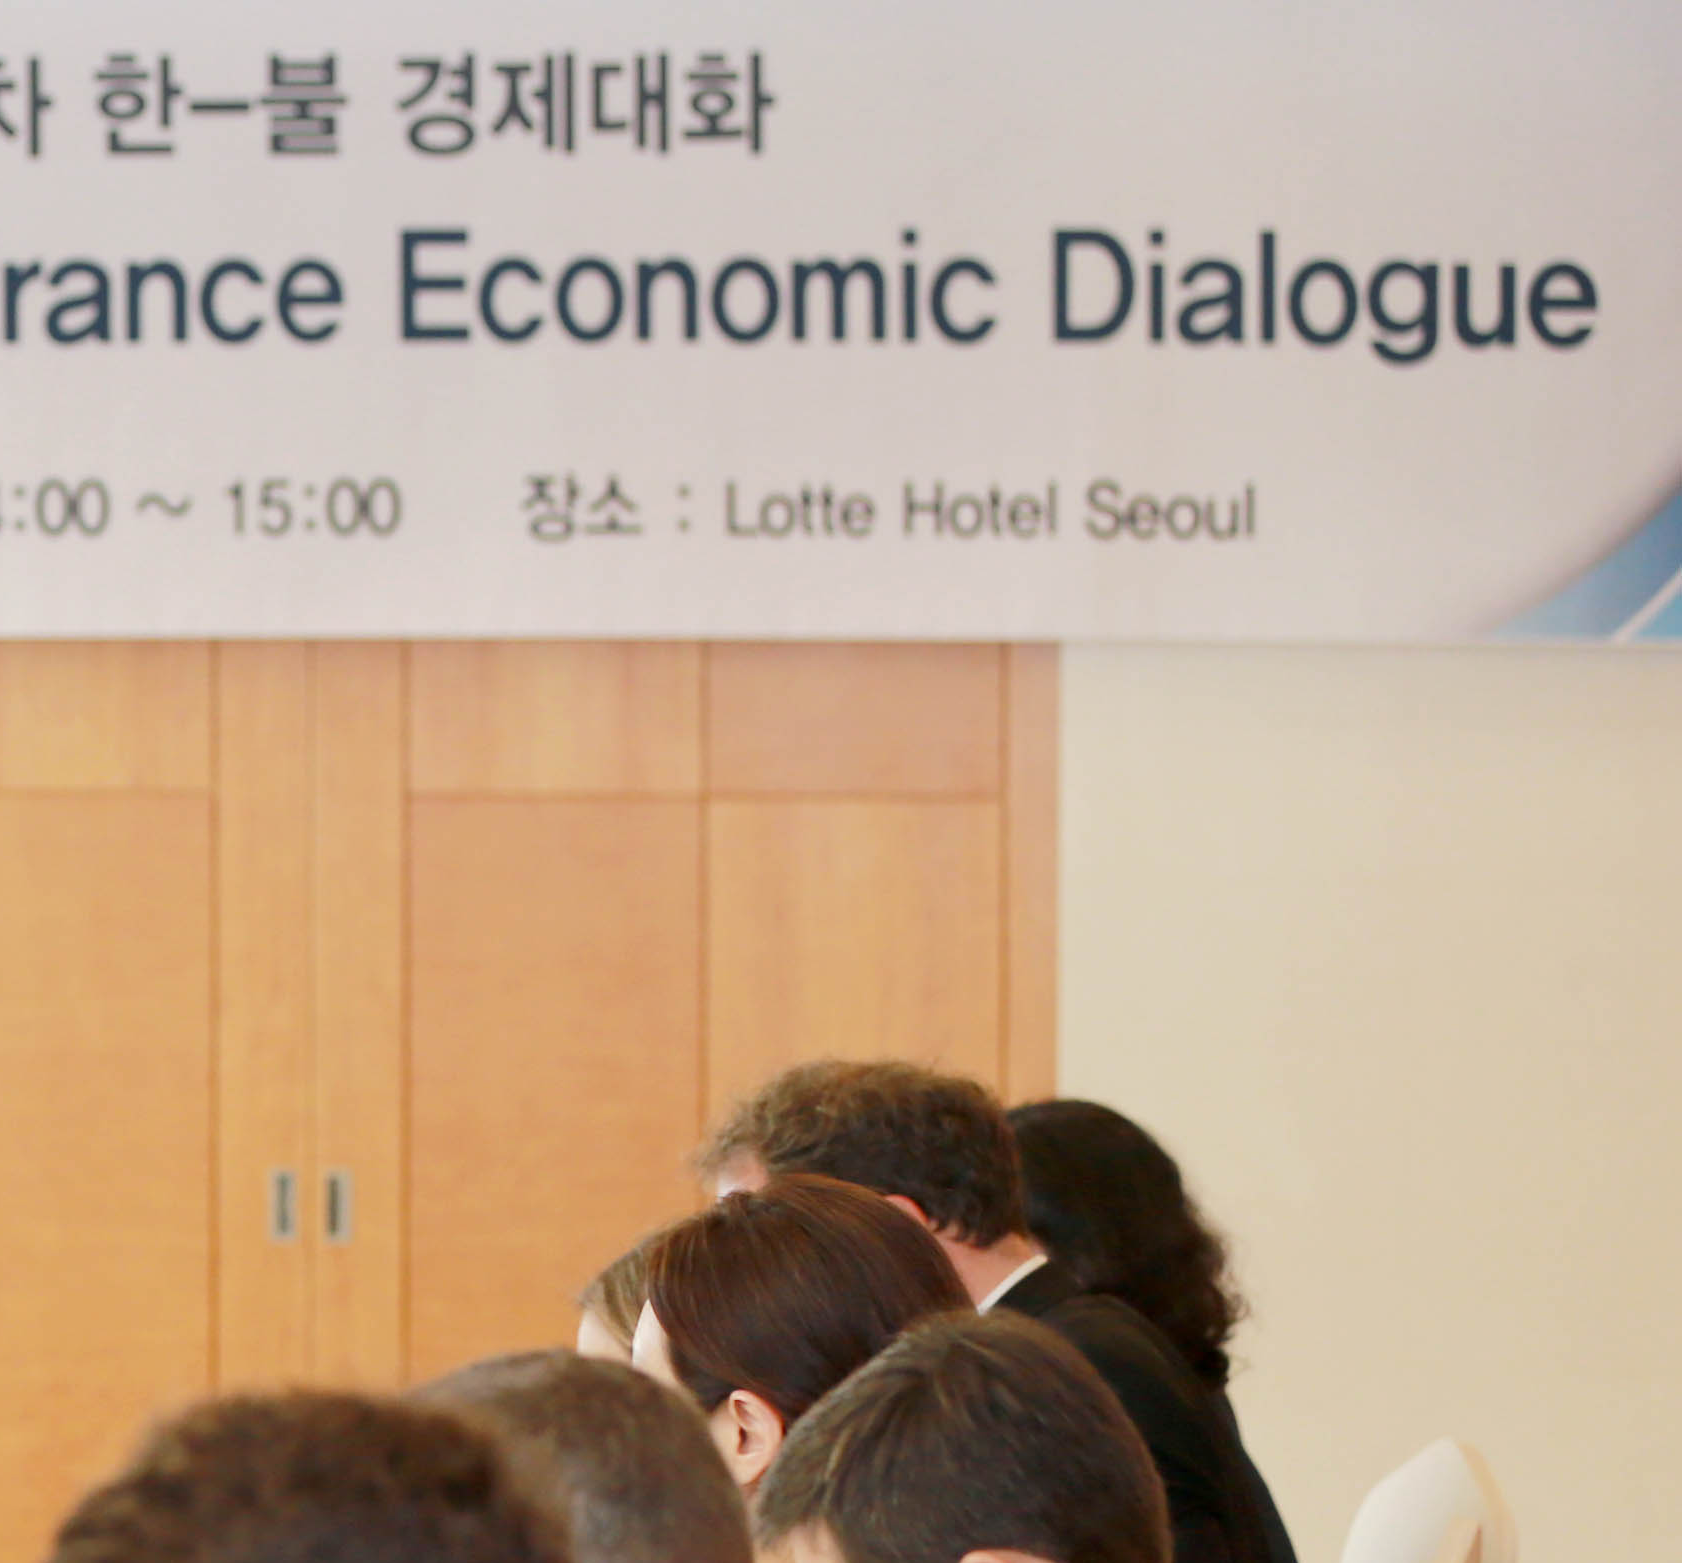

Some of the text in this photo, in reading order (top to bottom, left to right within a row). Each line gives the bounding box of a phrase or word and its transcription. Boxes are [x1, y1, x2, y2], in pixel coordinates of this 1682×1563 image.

[395, 48, 777, 159] 경제대화
[397, 227, 997, 348] Economic
[1050, 226, 1600, 368] Dialogue
[226, 476, 404, 538] 15:00
[522, 473, 1257, 544] 장소 : Lotte Hotel Seoul
